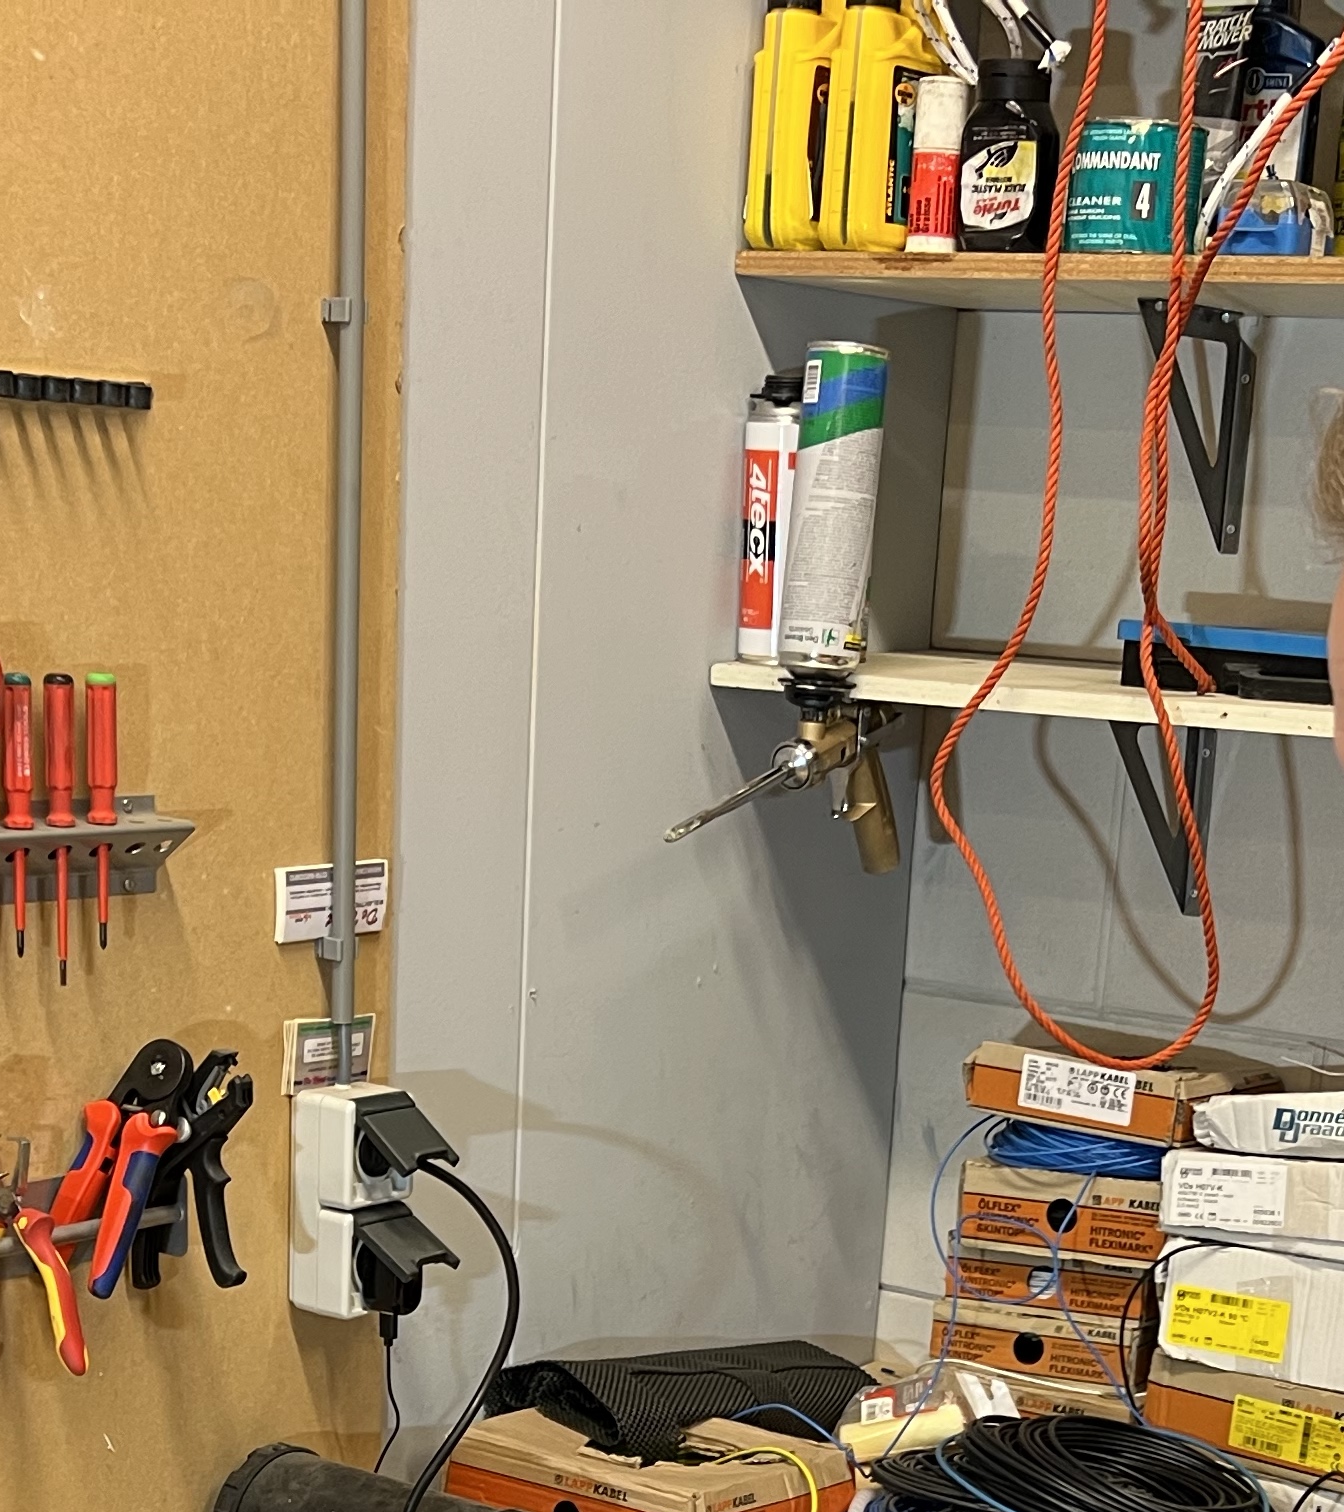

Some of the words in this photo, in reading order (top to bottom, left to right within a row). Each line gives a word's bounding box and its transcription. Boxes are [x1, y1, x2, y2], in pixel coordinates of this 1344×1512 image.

[971, 184, 1002, 193] PLASTIC
[1134, 182, 1152, 220] 4
[593, 1483, 628, 1503] KABEL
